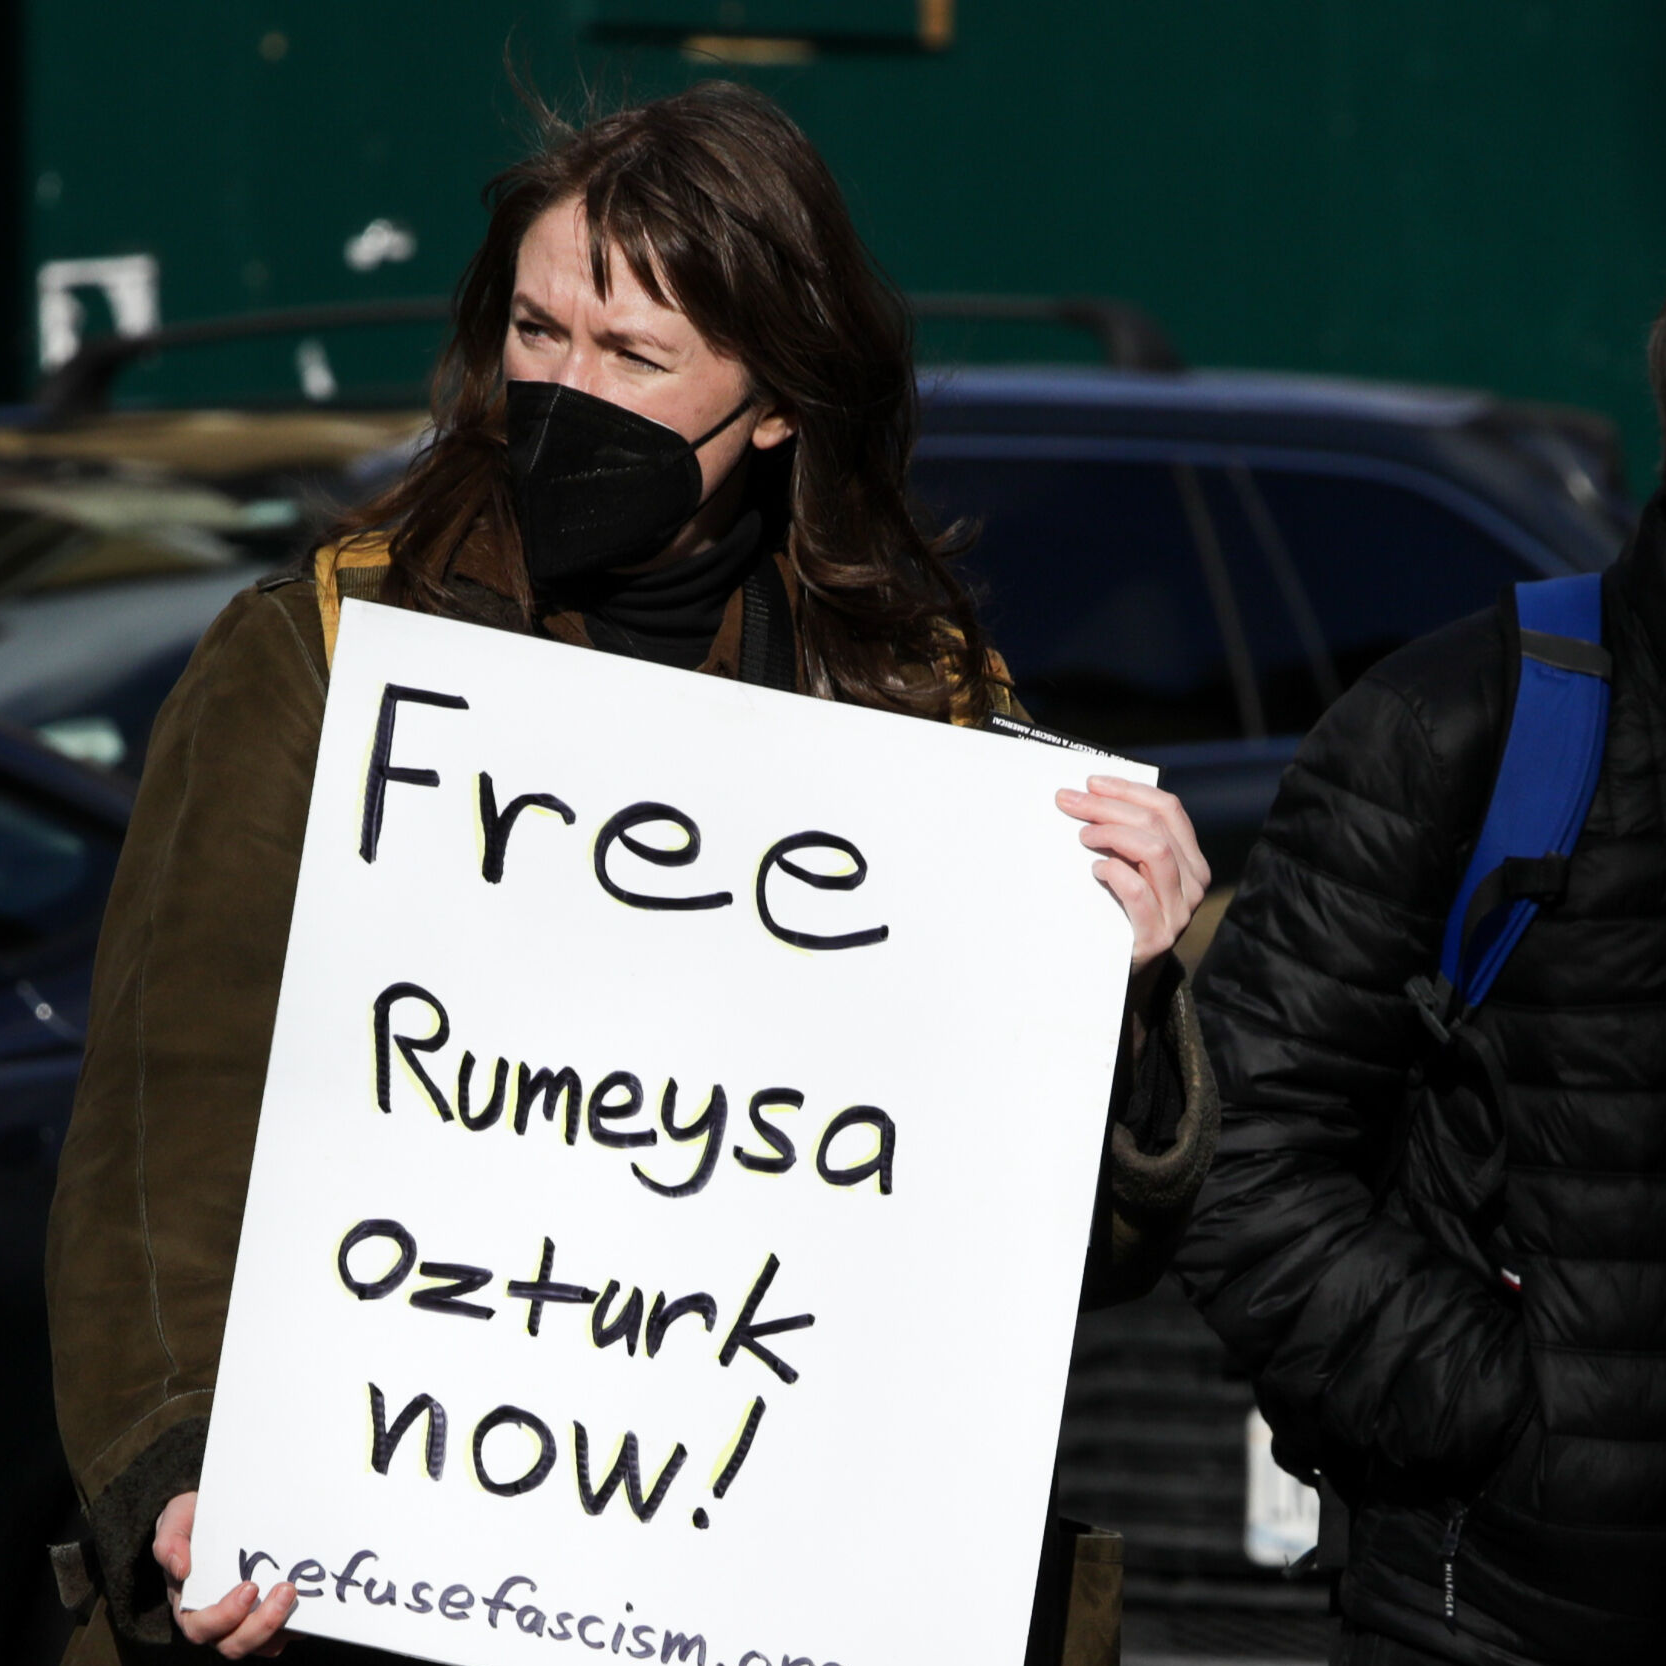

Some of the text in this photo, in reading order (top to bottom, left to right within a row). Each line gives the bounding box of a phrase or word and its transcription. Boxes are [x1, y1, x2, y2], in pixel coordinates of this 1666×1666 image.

[992, 716, 1031, 735] AMERICA!
[1030, 728, 1062, 745] FASCIST
[359, 683, 889, 950] Free
[374, 982, 895, 1197] Rumeysa
[369, 1383, 766, 1529] now!
[1445, 1563, 1455, 1617] HILFIGER
